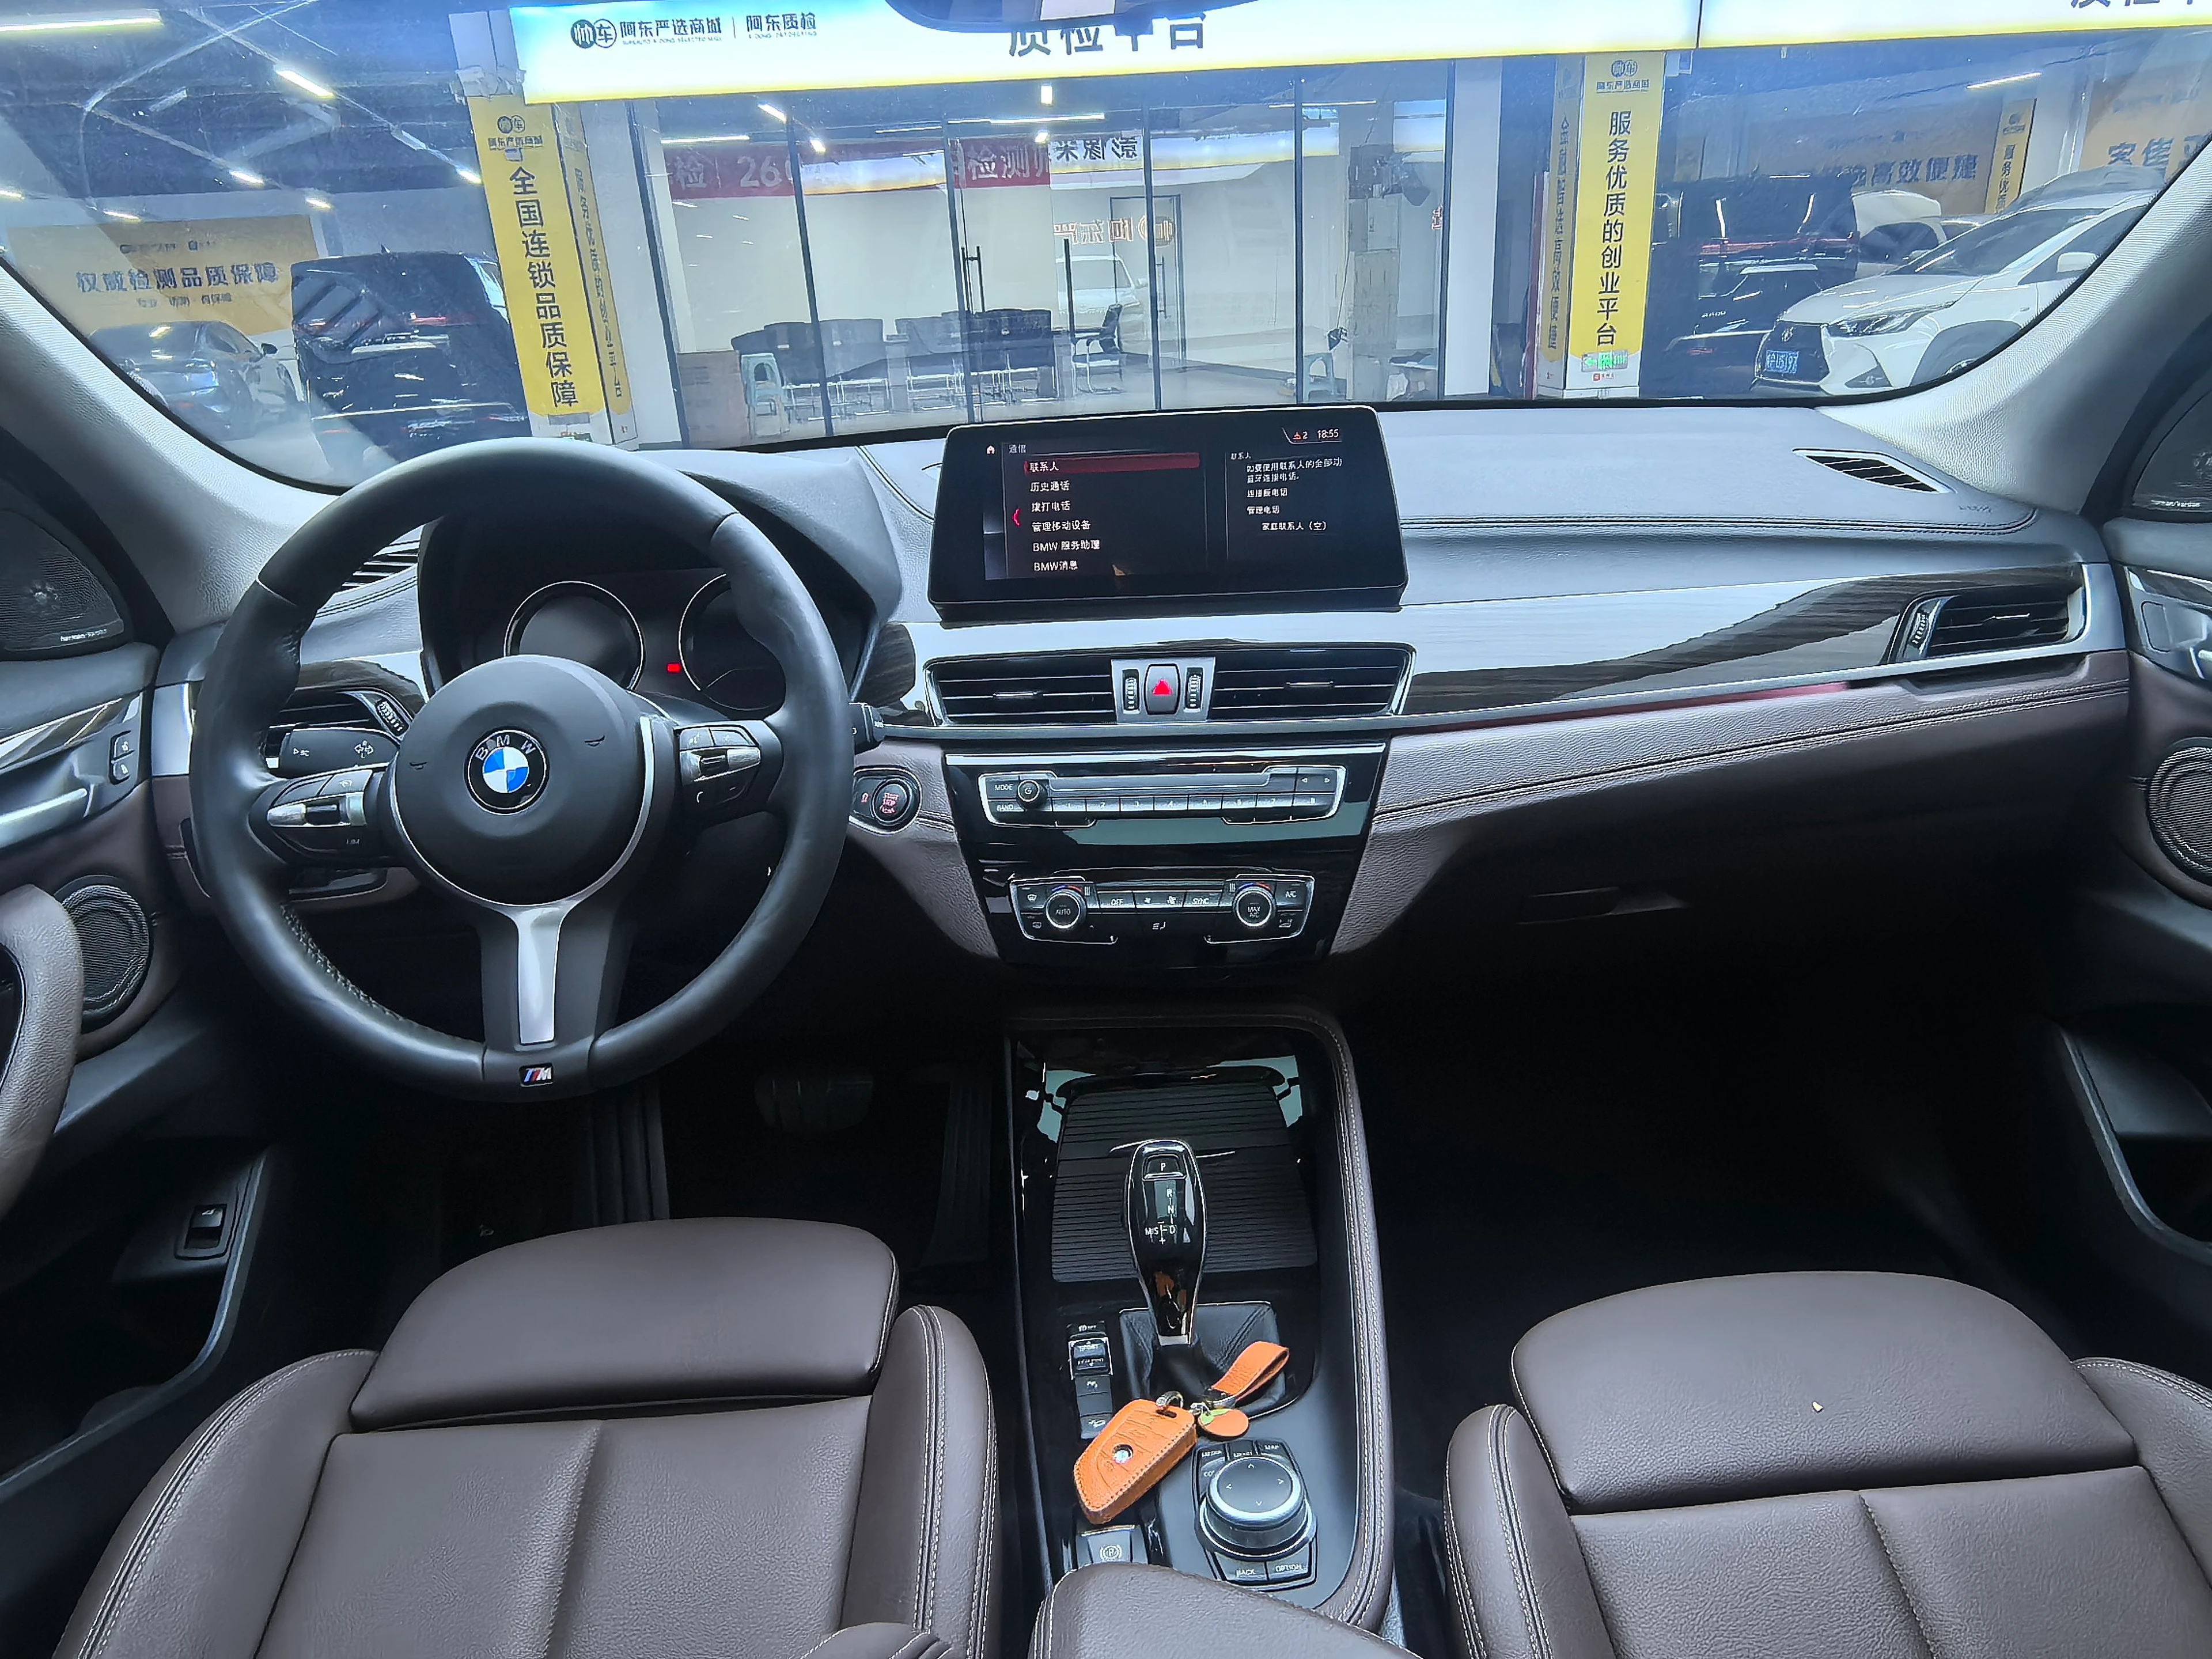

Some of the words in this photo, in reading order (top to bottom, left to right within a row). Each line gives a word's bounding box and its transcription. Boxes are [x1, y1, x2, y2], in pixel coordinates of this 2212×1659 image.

[620, 17, 722, 38] 阿东严选商城
[747, 12, 817, 33] 阿东质检
[1596, 111, 1631, 347] 服务优质的创业平台
[509, 166, 578, 407] 全国连锁品质保障
[1317, 429, 1339, 439] 18:55
[1029, 461, 1059, 472] 联系人
[1030, 480, 1070, 493] 历史通话
[1031, 501, 1071, 513] 拨打电话
[1032, 520, 1091, 533] 管理移动设备
[1033, 543, 1058, 552] BMW
[1060, 540, 1100, 551] 服务助理
[475, 734, 536, 761] BMW
[1160, 1162, 1166, 1172] P
[1166, 1188, 1173, 1198] R
[1168, 1205, 1174, 1214] N
[1169, 1225, 1176, 1234] D
[1275, 1563, 1302, 1573] OPTION
